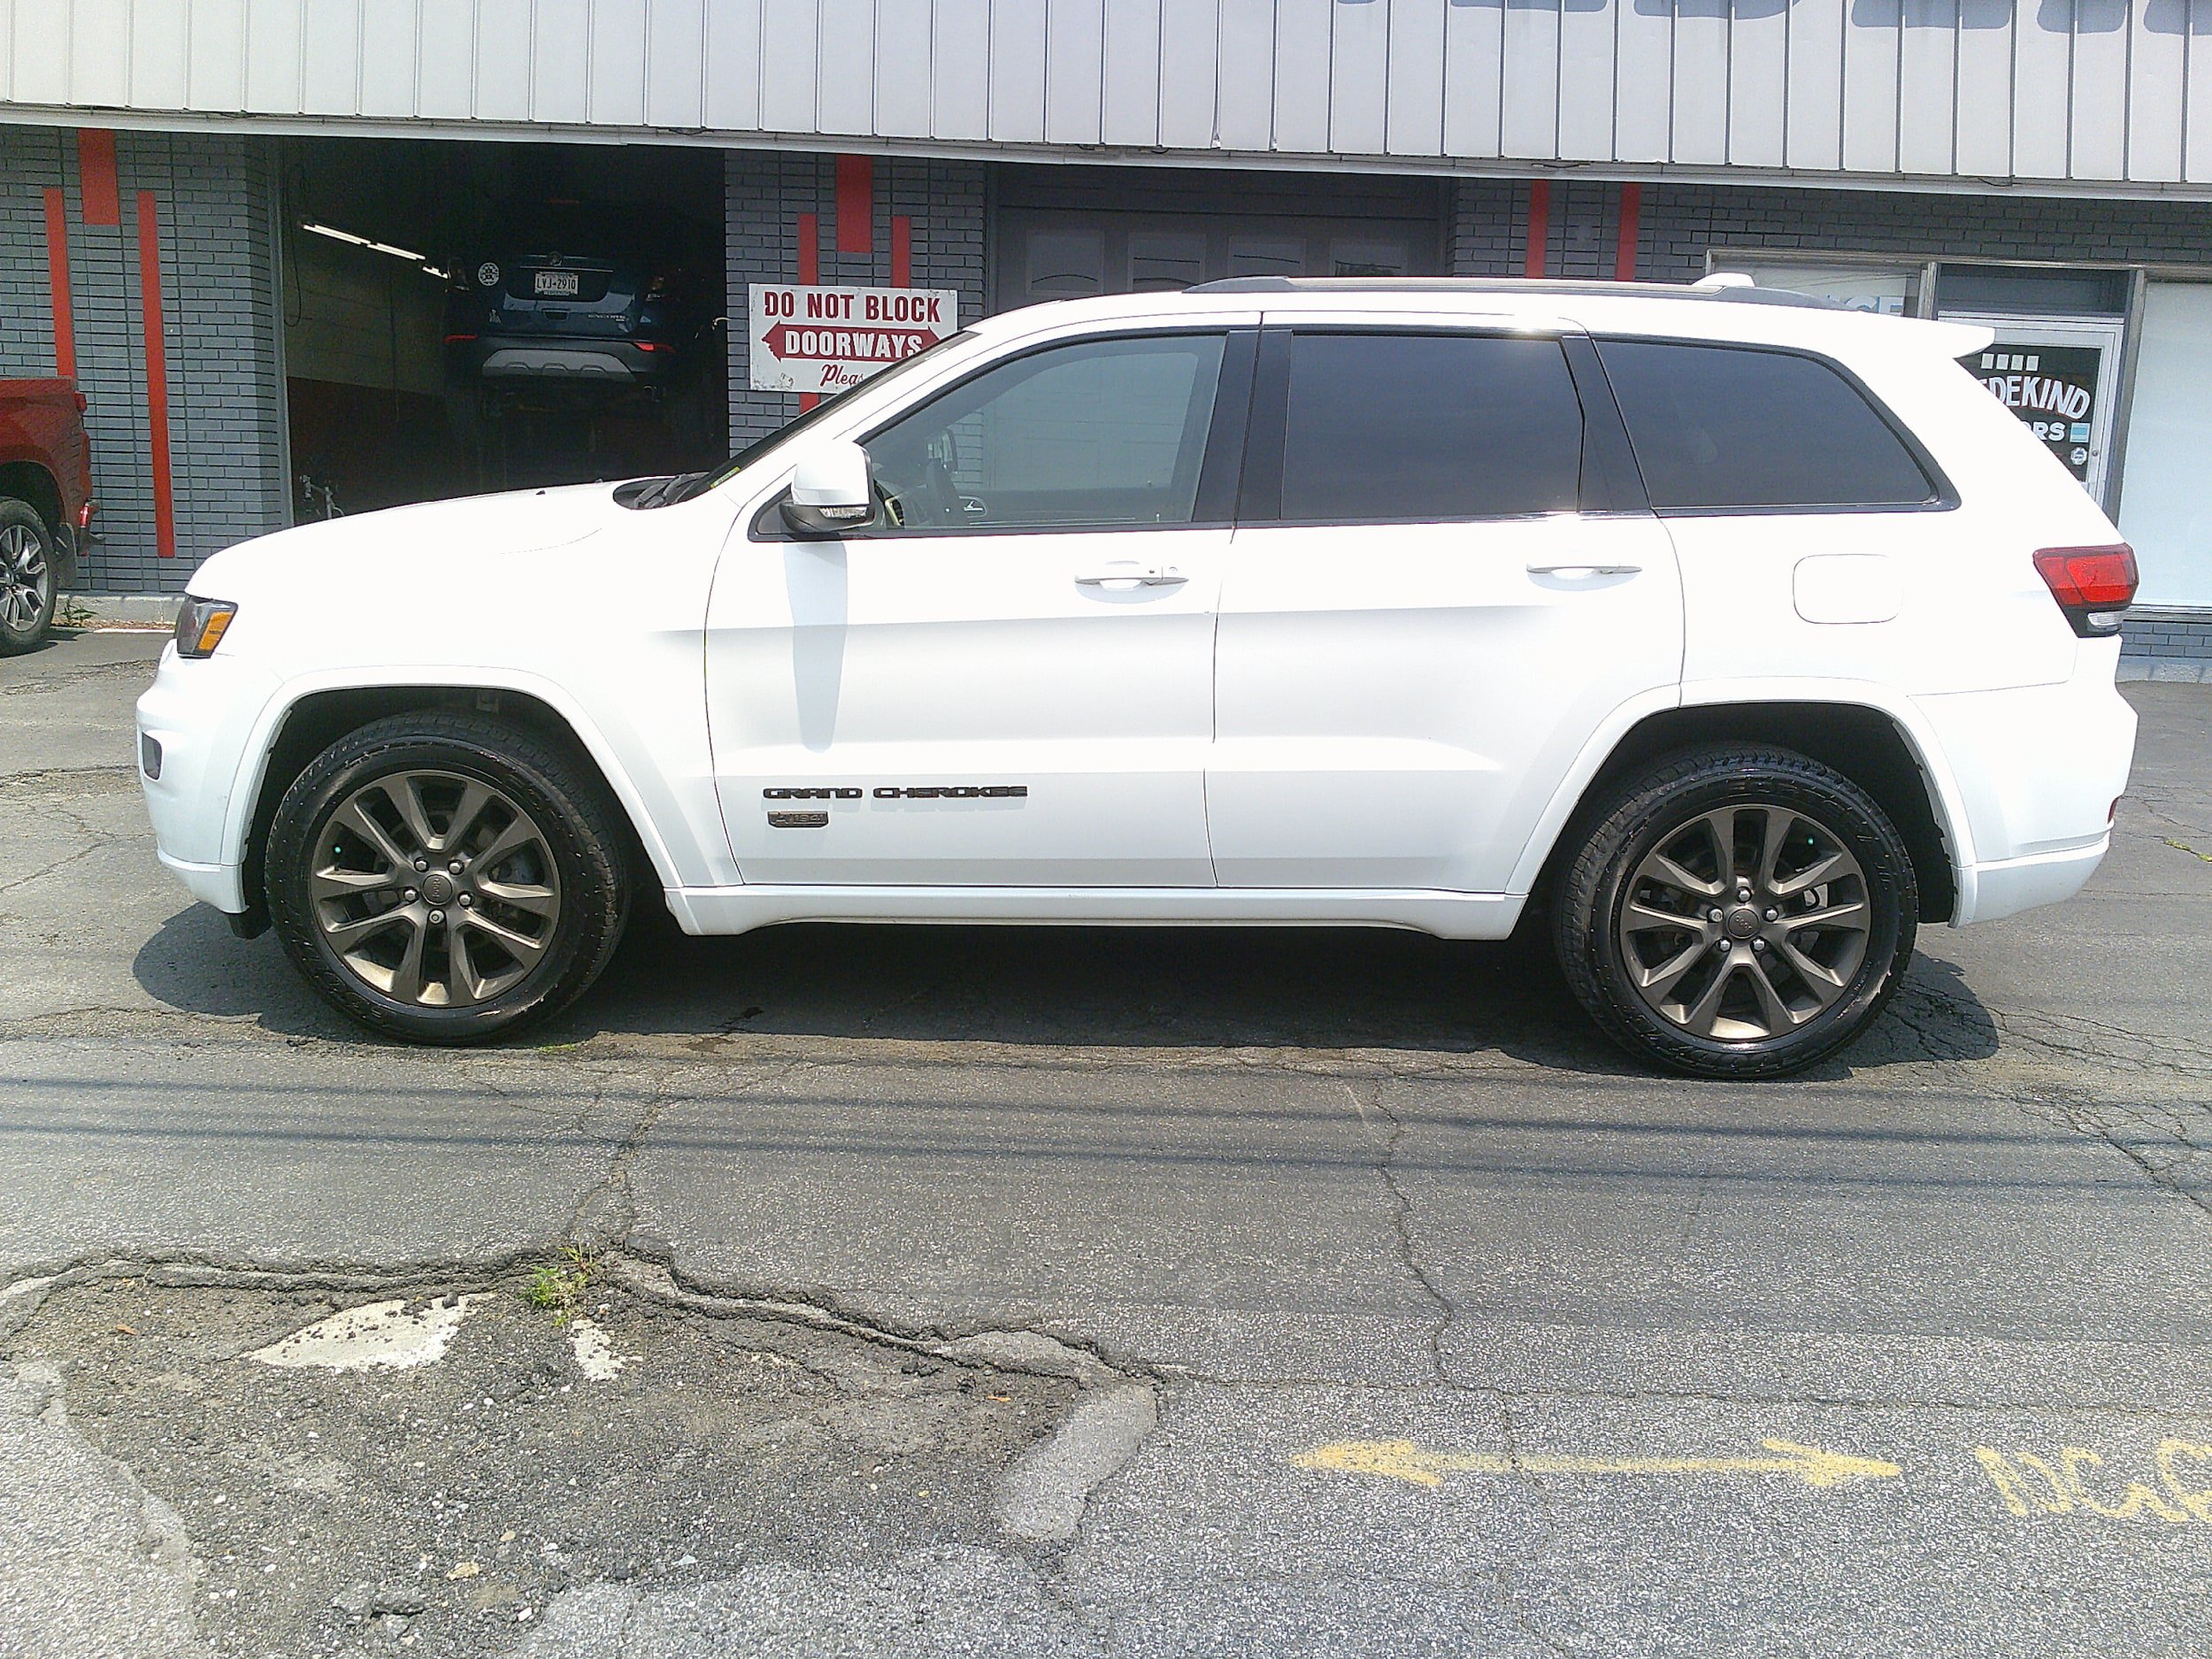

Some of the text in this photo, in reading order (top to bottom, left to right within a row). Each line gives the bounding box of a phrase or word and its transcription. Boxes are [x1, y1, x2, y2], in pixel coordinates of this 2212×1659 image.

[764, 292, 941, 322] DO NOT BLOCK
[785, 331, 922, 357] DOORWAYS
[763, 786, 1028, 798] GRAND CHEROKEE
